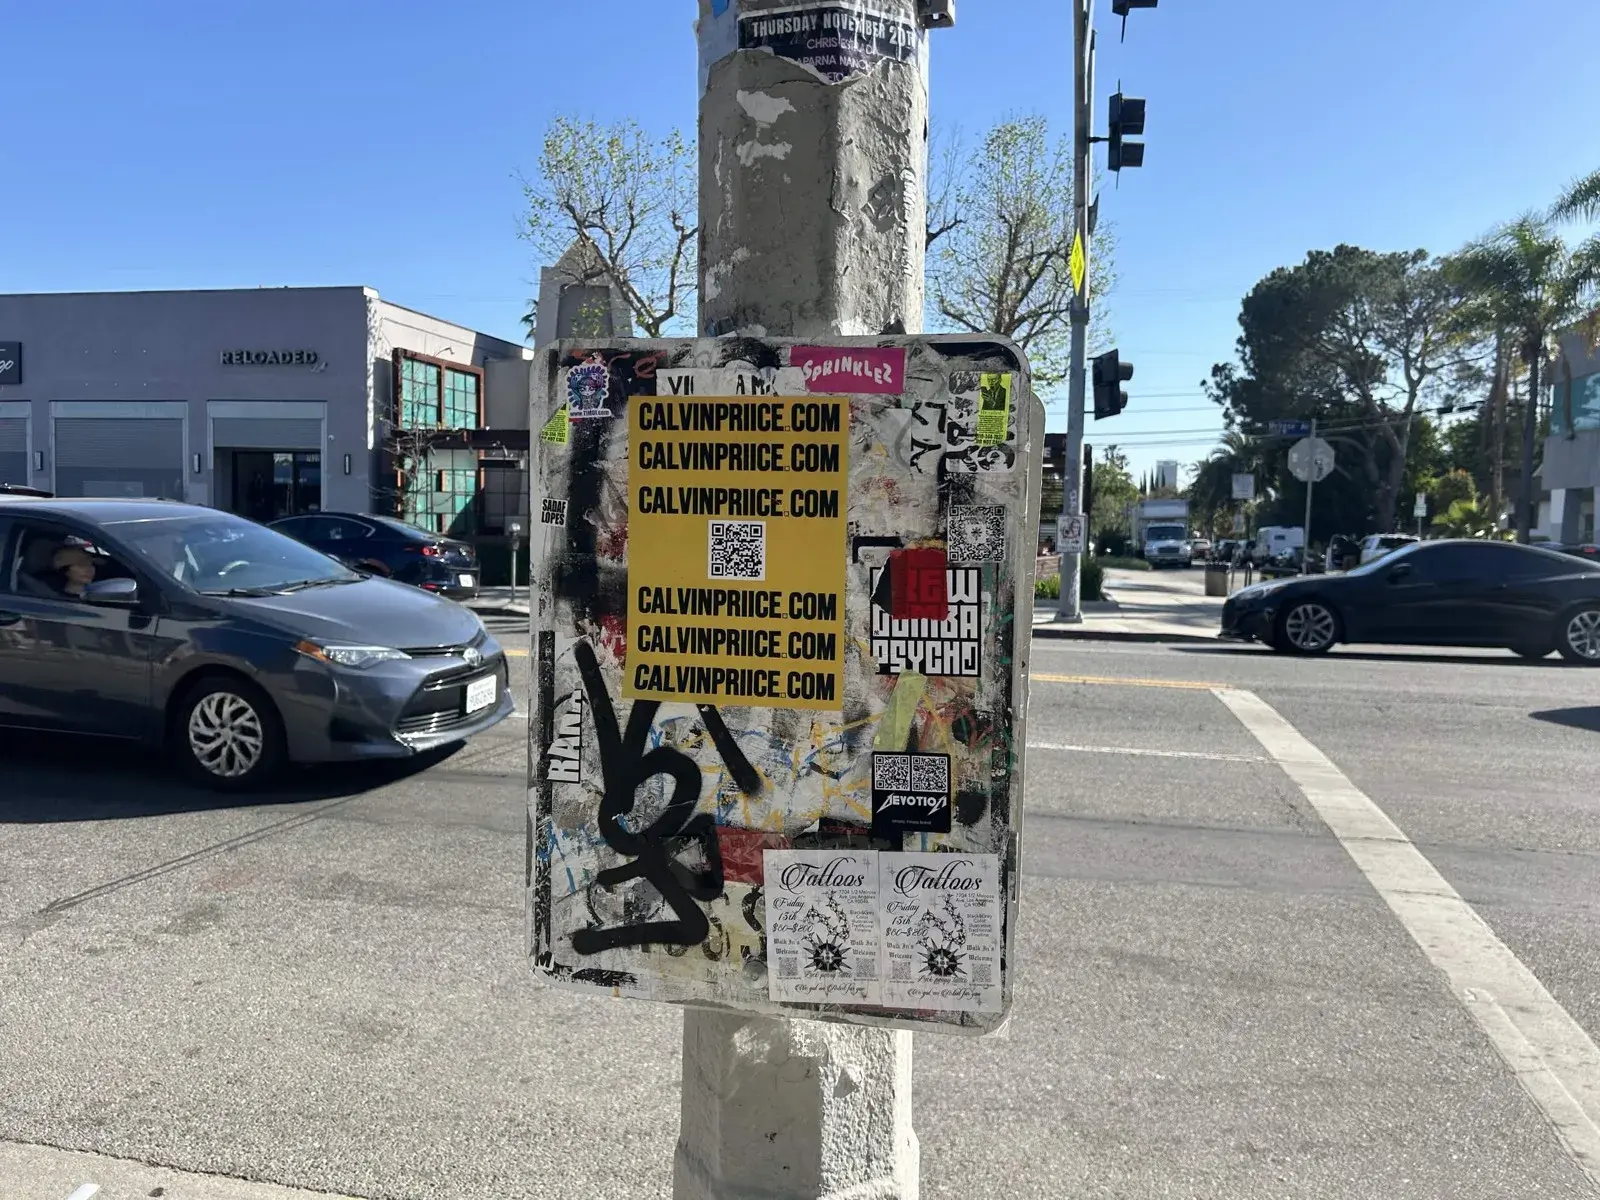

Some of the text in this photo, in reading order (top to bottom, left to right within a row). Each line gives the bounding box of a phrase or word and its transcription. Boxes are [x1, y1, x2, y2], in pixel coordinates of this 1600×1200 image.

[752, 14, 817, 38] THURSDAY
[806, 38, 837, 50] CHRIS
[220, 350, 318, 365] RELOADED
[802, 356, 892, 385] SPRINKLEZ
[639, 402, 840, 432] CALVINPRIICE.COM
[639, 441, 839, 473] CALVINPRIICE.COM
[542, 499, 566, 514] SADAF
[638, 485, 839, 518] CALVINPRIICE.COM
[541, 512, 565, 526] LOPES
[638, 586, 837, 621] CALVINPRIICE.COM
[637, 624, 836, 661] CALVINPRIICE.COM
[872, 639, 978, 675] PSYCHO
[634, 663, 835, 701] CALVINPRIICE.COM
[779, 857, 865, 894] Tattoos
[893, 860, 982, 898] Tattoos
[772, 896, 806, 913] Friday
[886, 899, 920, 917] Friday
